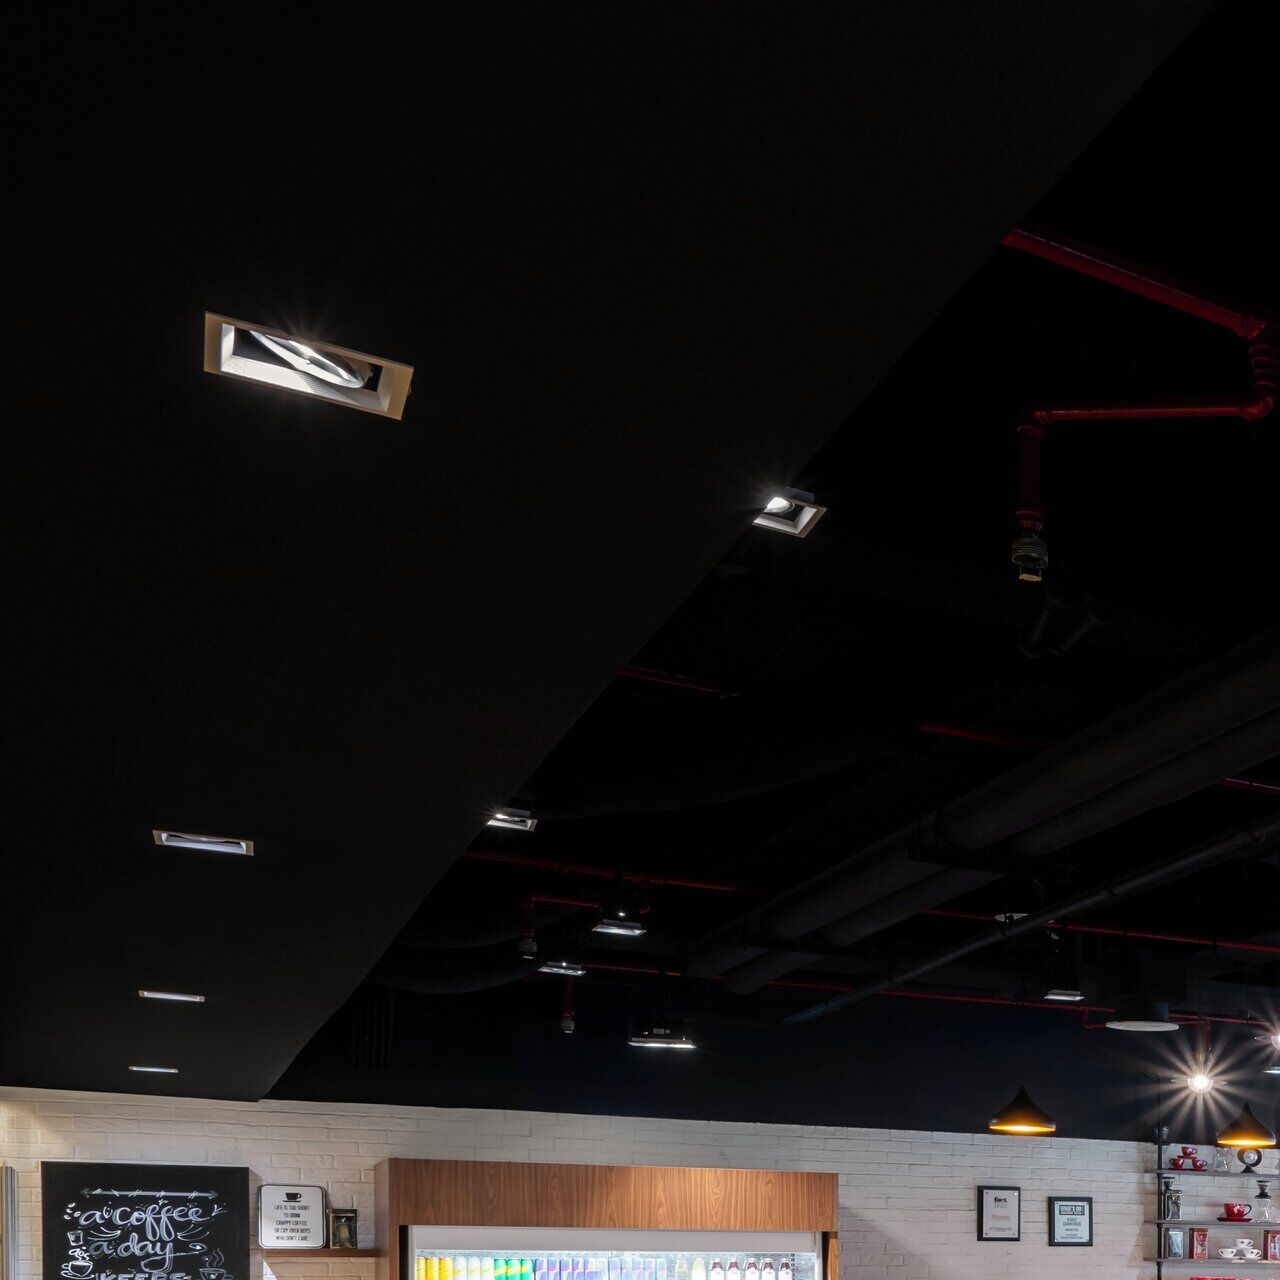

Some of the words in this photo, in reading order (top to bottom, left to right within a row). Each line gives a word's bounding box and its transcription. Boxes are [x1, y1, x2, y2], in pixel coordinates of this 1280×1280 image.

[79, 1210, 105, 1226] a
[111, 1204, 210, 1241] coffee
[88, 1241, 115, 1257] a
[117, 1232, 174, 1273] day
